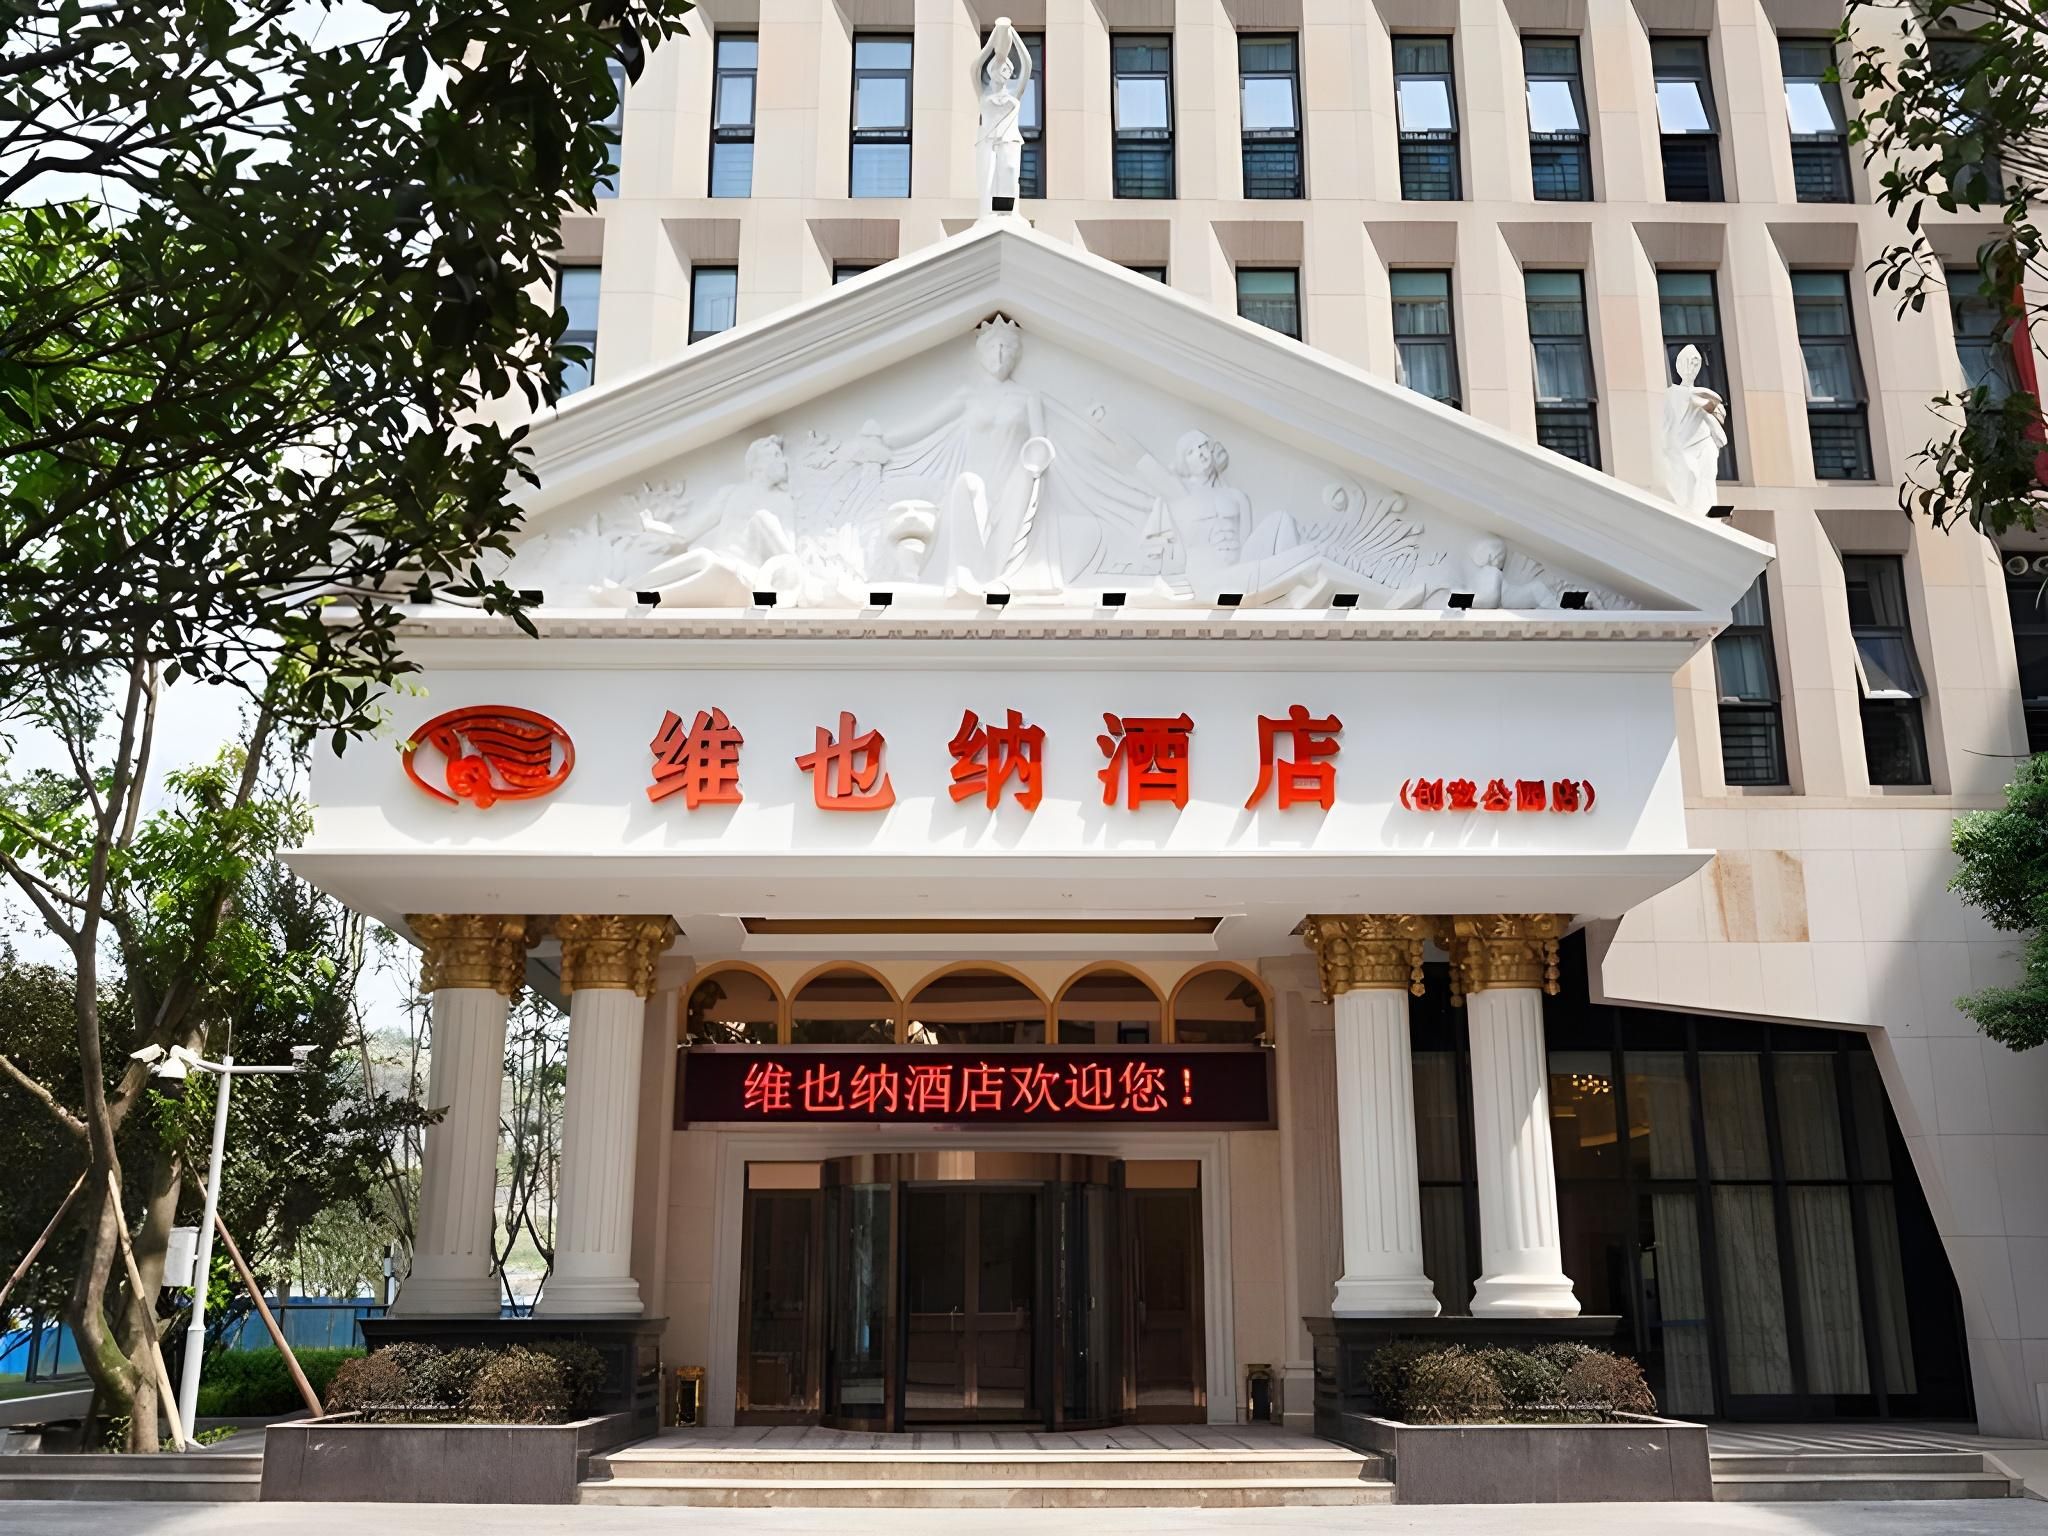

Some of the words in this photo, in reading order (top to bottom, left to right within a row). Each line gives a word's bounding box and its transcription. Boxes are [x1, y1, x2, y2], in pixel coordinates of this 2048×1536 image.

[647, 705, 1342, 812] 维也纳酒店
[743, 1061, 1193, 1114] 维也纳酒店欢迎您！
